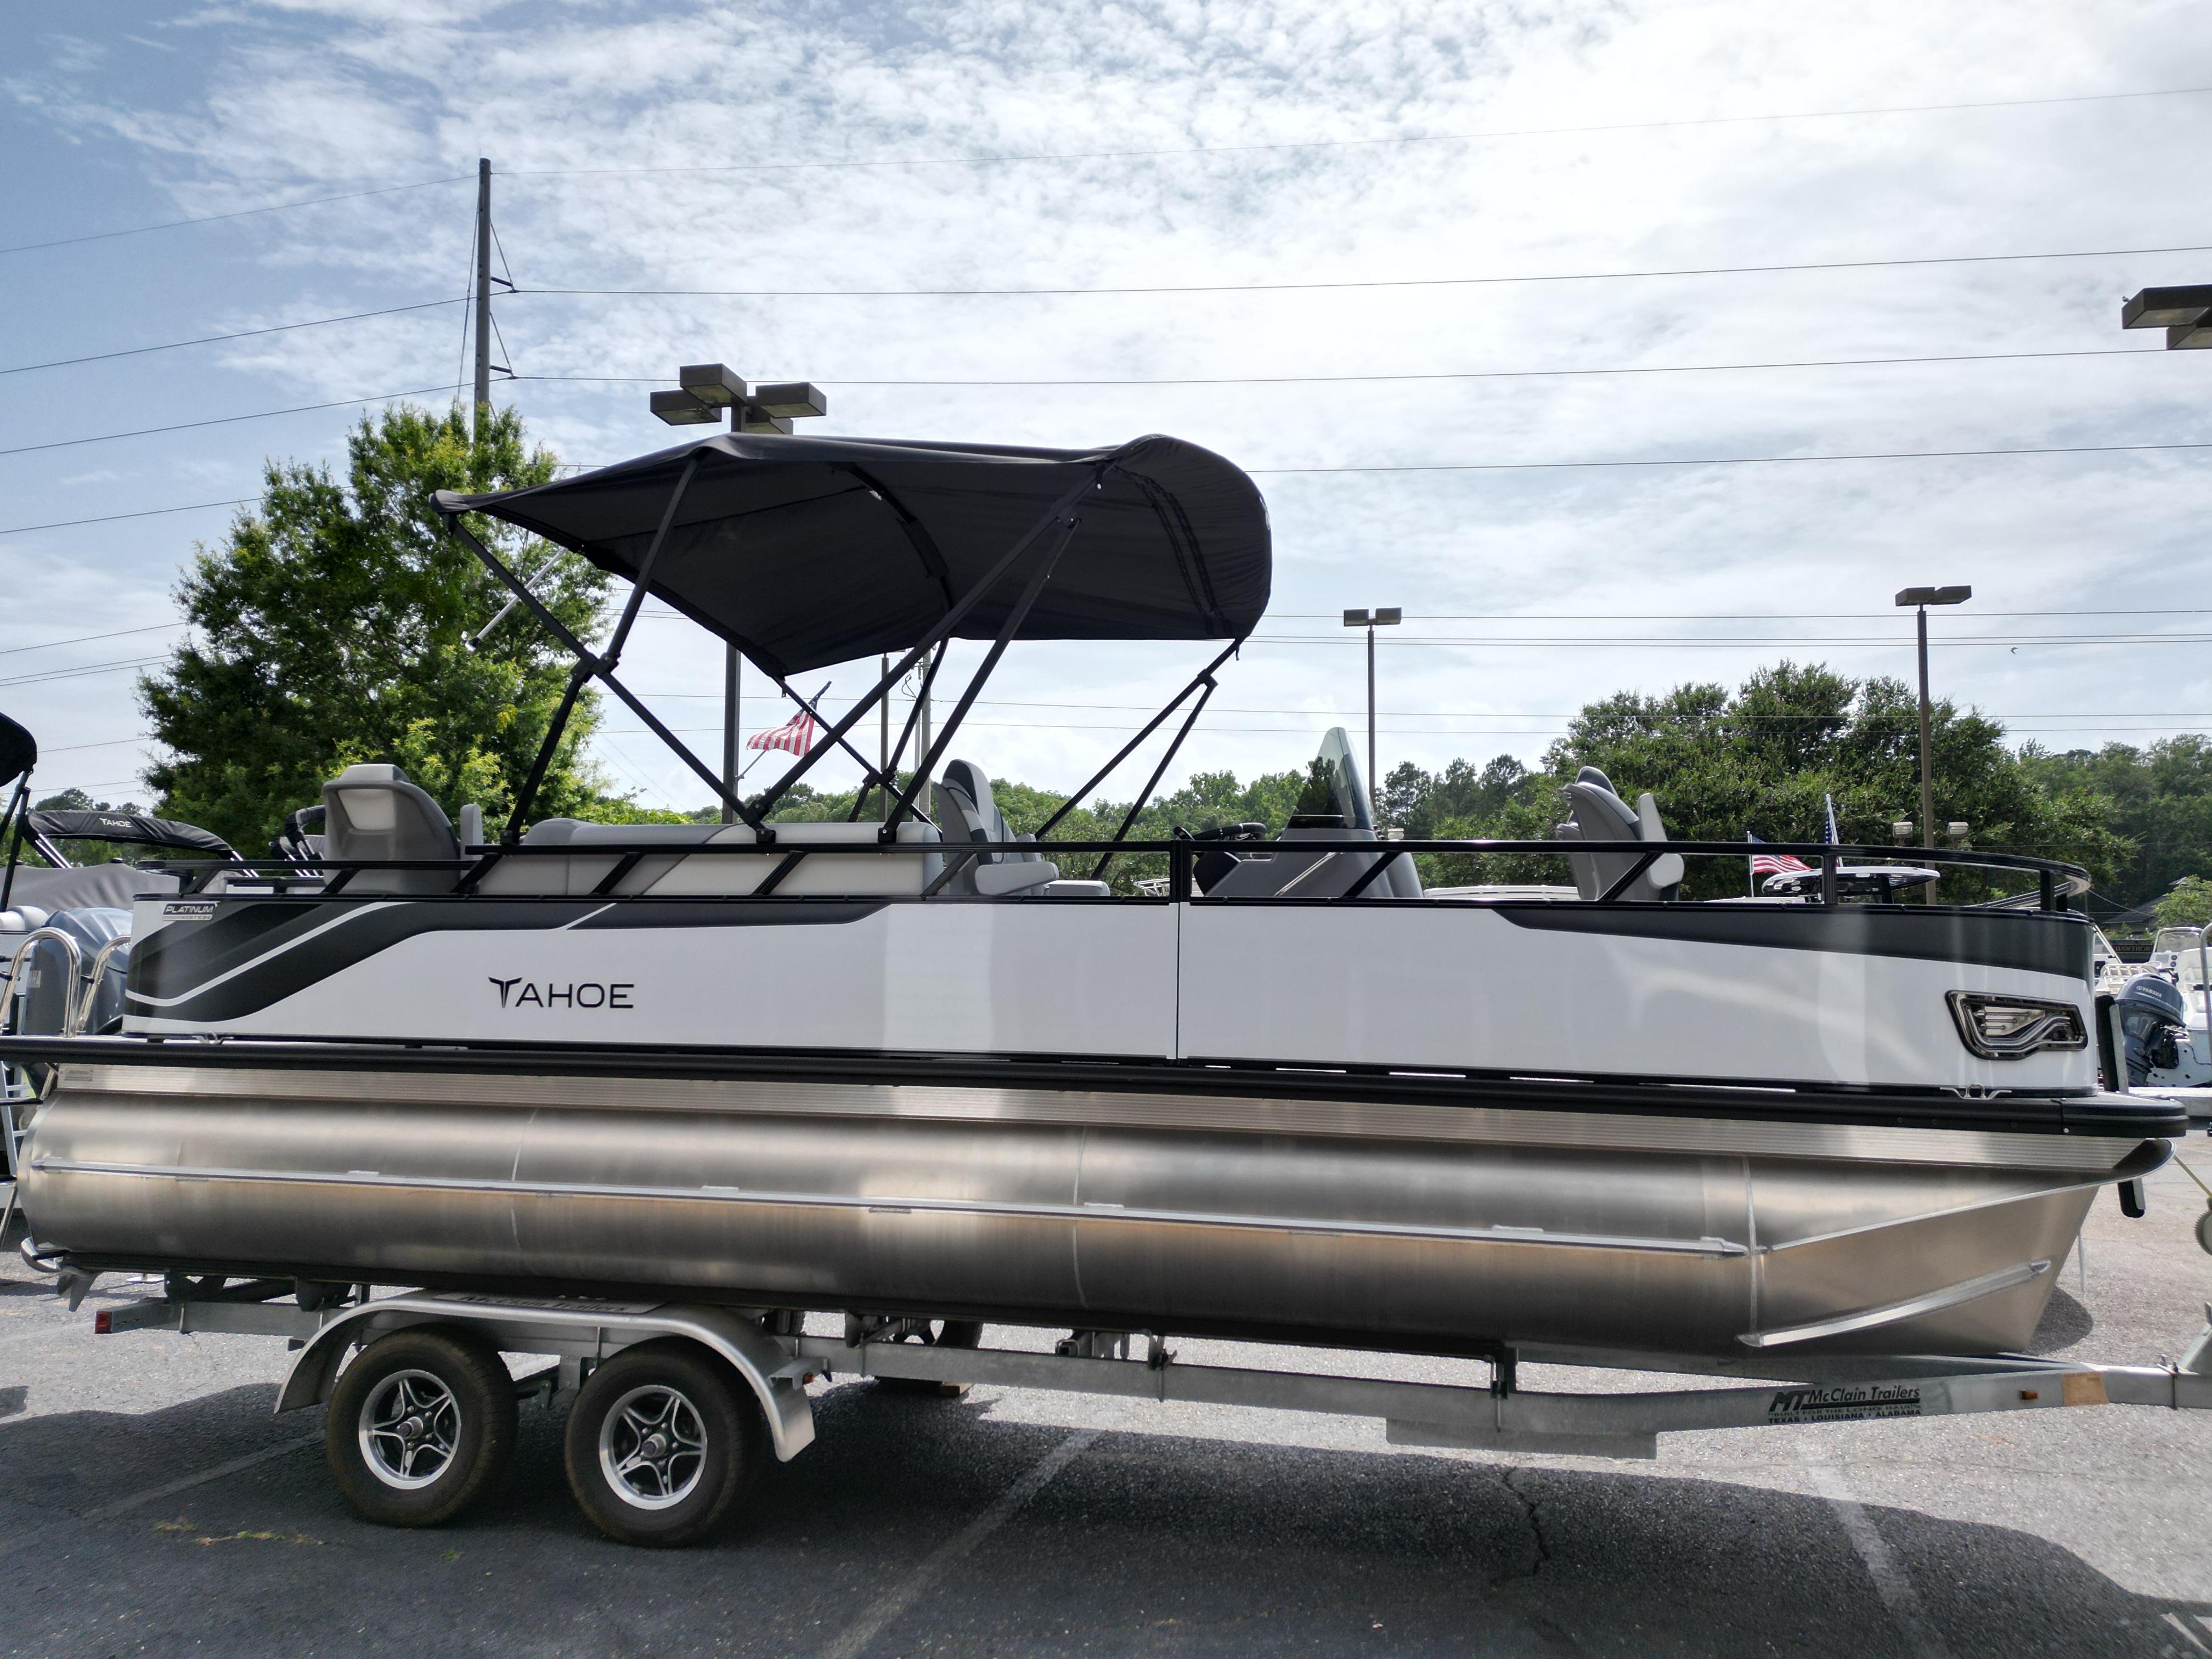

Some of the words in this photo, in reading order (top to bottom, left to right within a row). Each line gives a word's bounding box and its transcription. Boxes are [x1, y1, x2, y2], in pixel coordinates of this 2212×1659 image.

[99, 817, 132, 828] TAHOE
[488, 976, 634, 1008] TAHOE
[2142, 987, 2162, 997] YAMAHA
[1808, 1388, 1866, 1403] McClain
[1871, 1385, 1920, 1400] Trailers
[1768, 1415, 1801, 1424] TEXAS
[1812, 1412, 1865, 1421] LOUISIANA
[1875, 1409, 1921, 1418] ALABAMA
